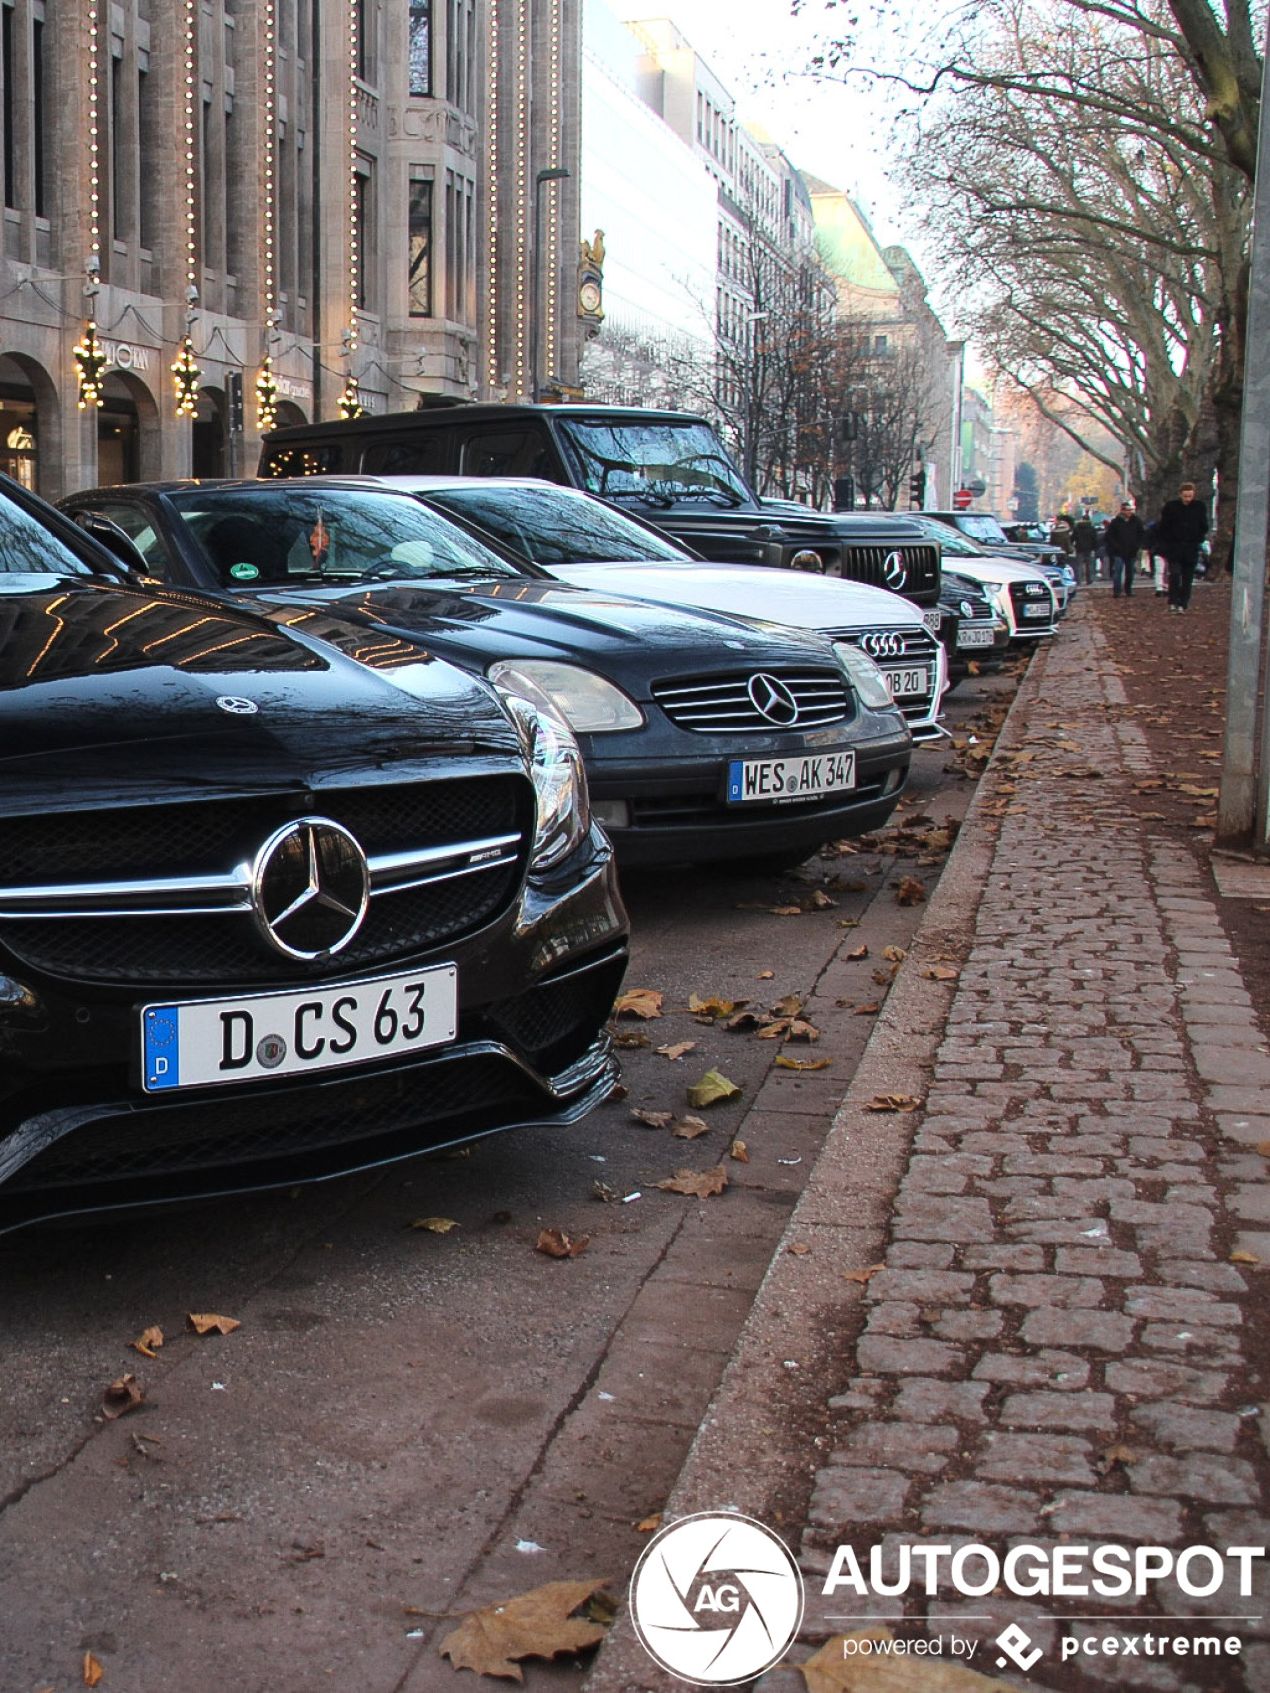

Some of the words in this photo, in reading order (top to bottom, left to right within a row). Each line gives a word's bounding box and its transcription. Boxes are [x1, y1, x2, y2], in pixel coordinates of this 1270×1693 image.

[904, 672, 919, 692] 20
[745, 763, 785, 795] WES
[800, 759, 822, 790] AK
[825, 754, 853, 786] 347
[155, 1057, 168, 1075] D
[219, 1010, 253, 1070] D
[294, 996, 357, 1059] CS
[374, 982, 425, 1045] 63
